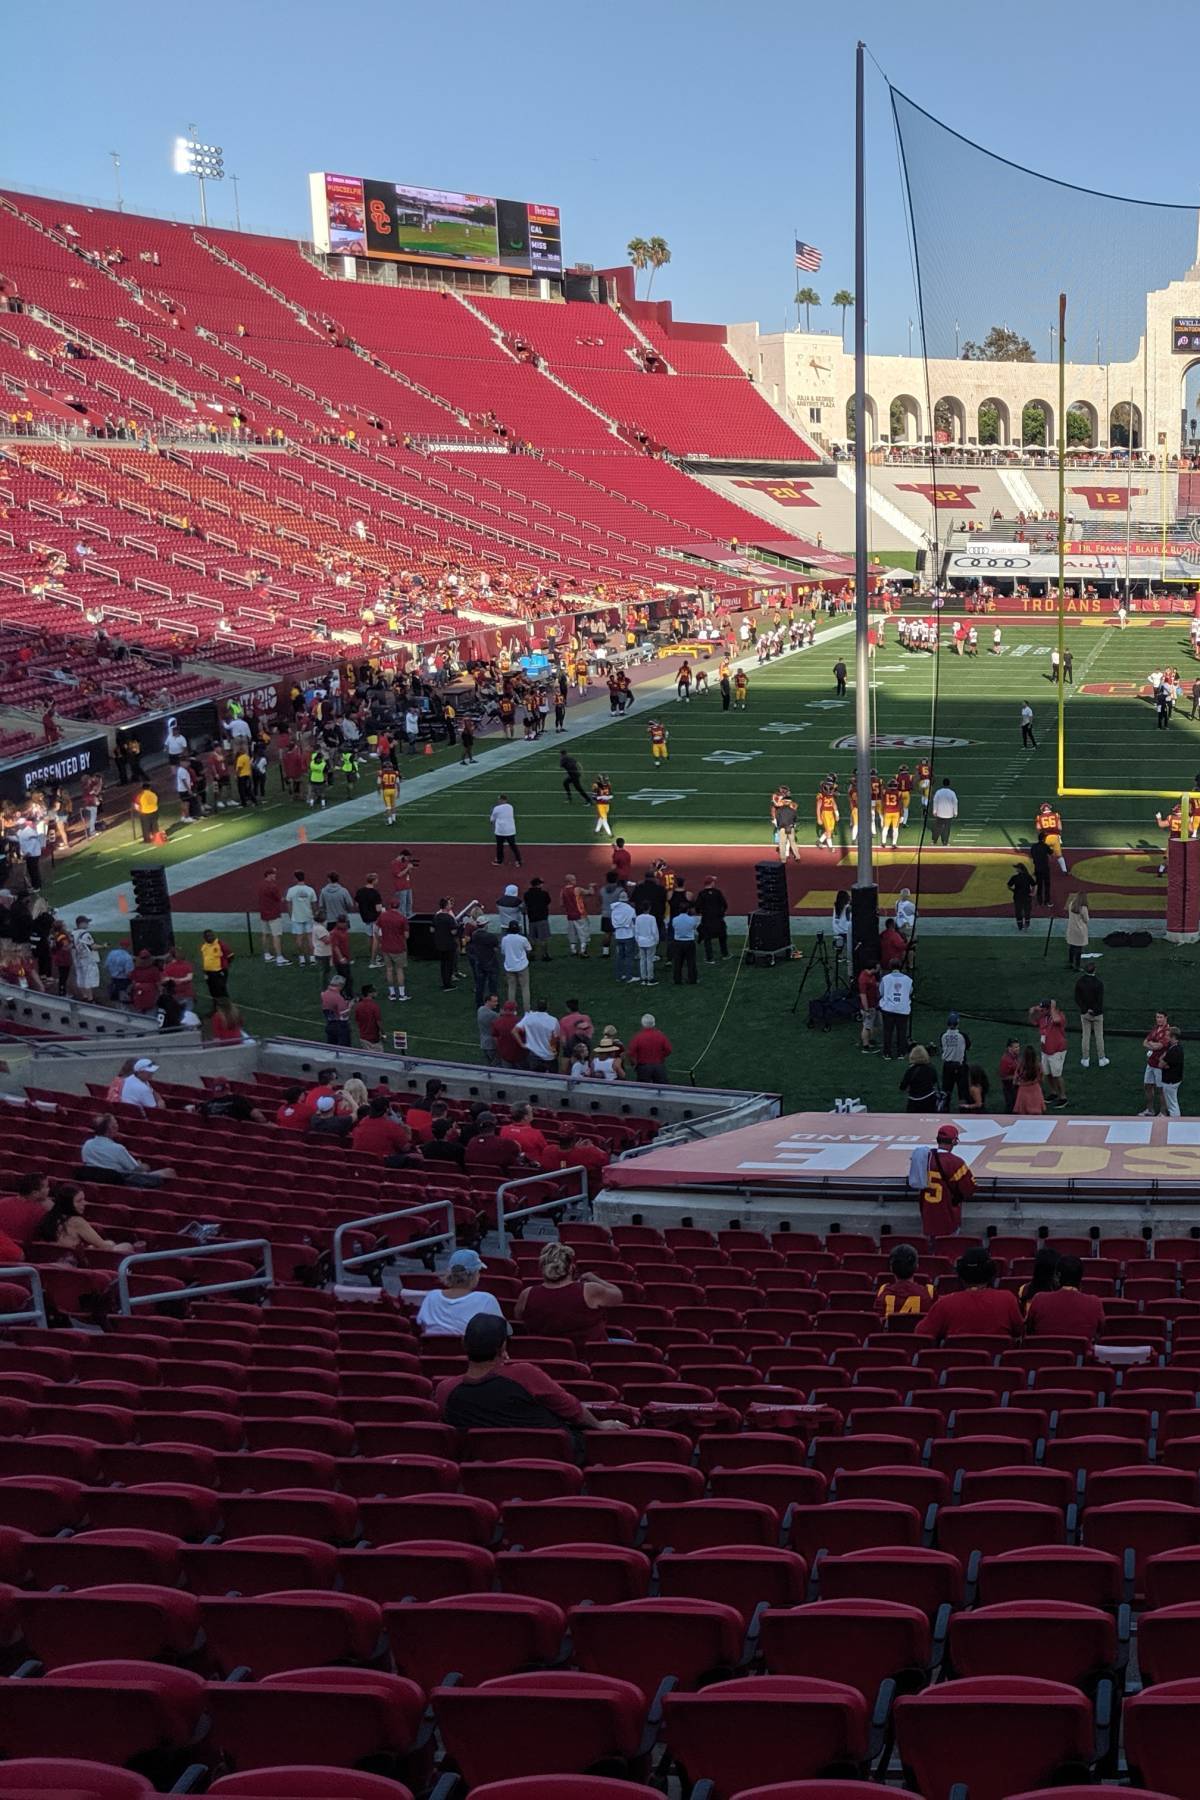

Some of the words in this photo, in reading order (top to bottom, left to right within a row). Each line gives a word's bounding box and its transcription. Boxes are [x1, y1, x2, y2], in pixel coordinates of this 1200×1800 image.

[530, 225, 543, 234] CAL
[531, 241, 547, 250] MISS
[772, 487, 801, 499] 20
[1095, 492, 1121, 503] 12
[1063, 561, 1120, 569] Audi
[80, 751, 91, 771] BY
[886, 793, 897, 806] 13
[1040, 815, 1056, 829] 66
[790, 1133, 921, 1142] BRAND
[924, 1170, 944, 1204] 5
[884, 1295, 921, 1318] 14
